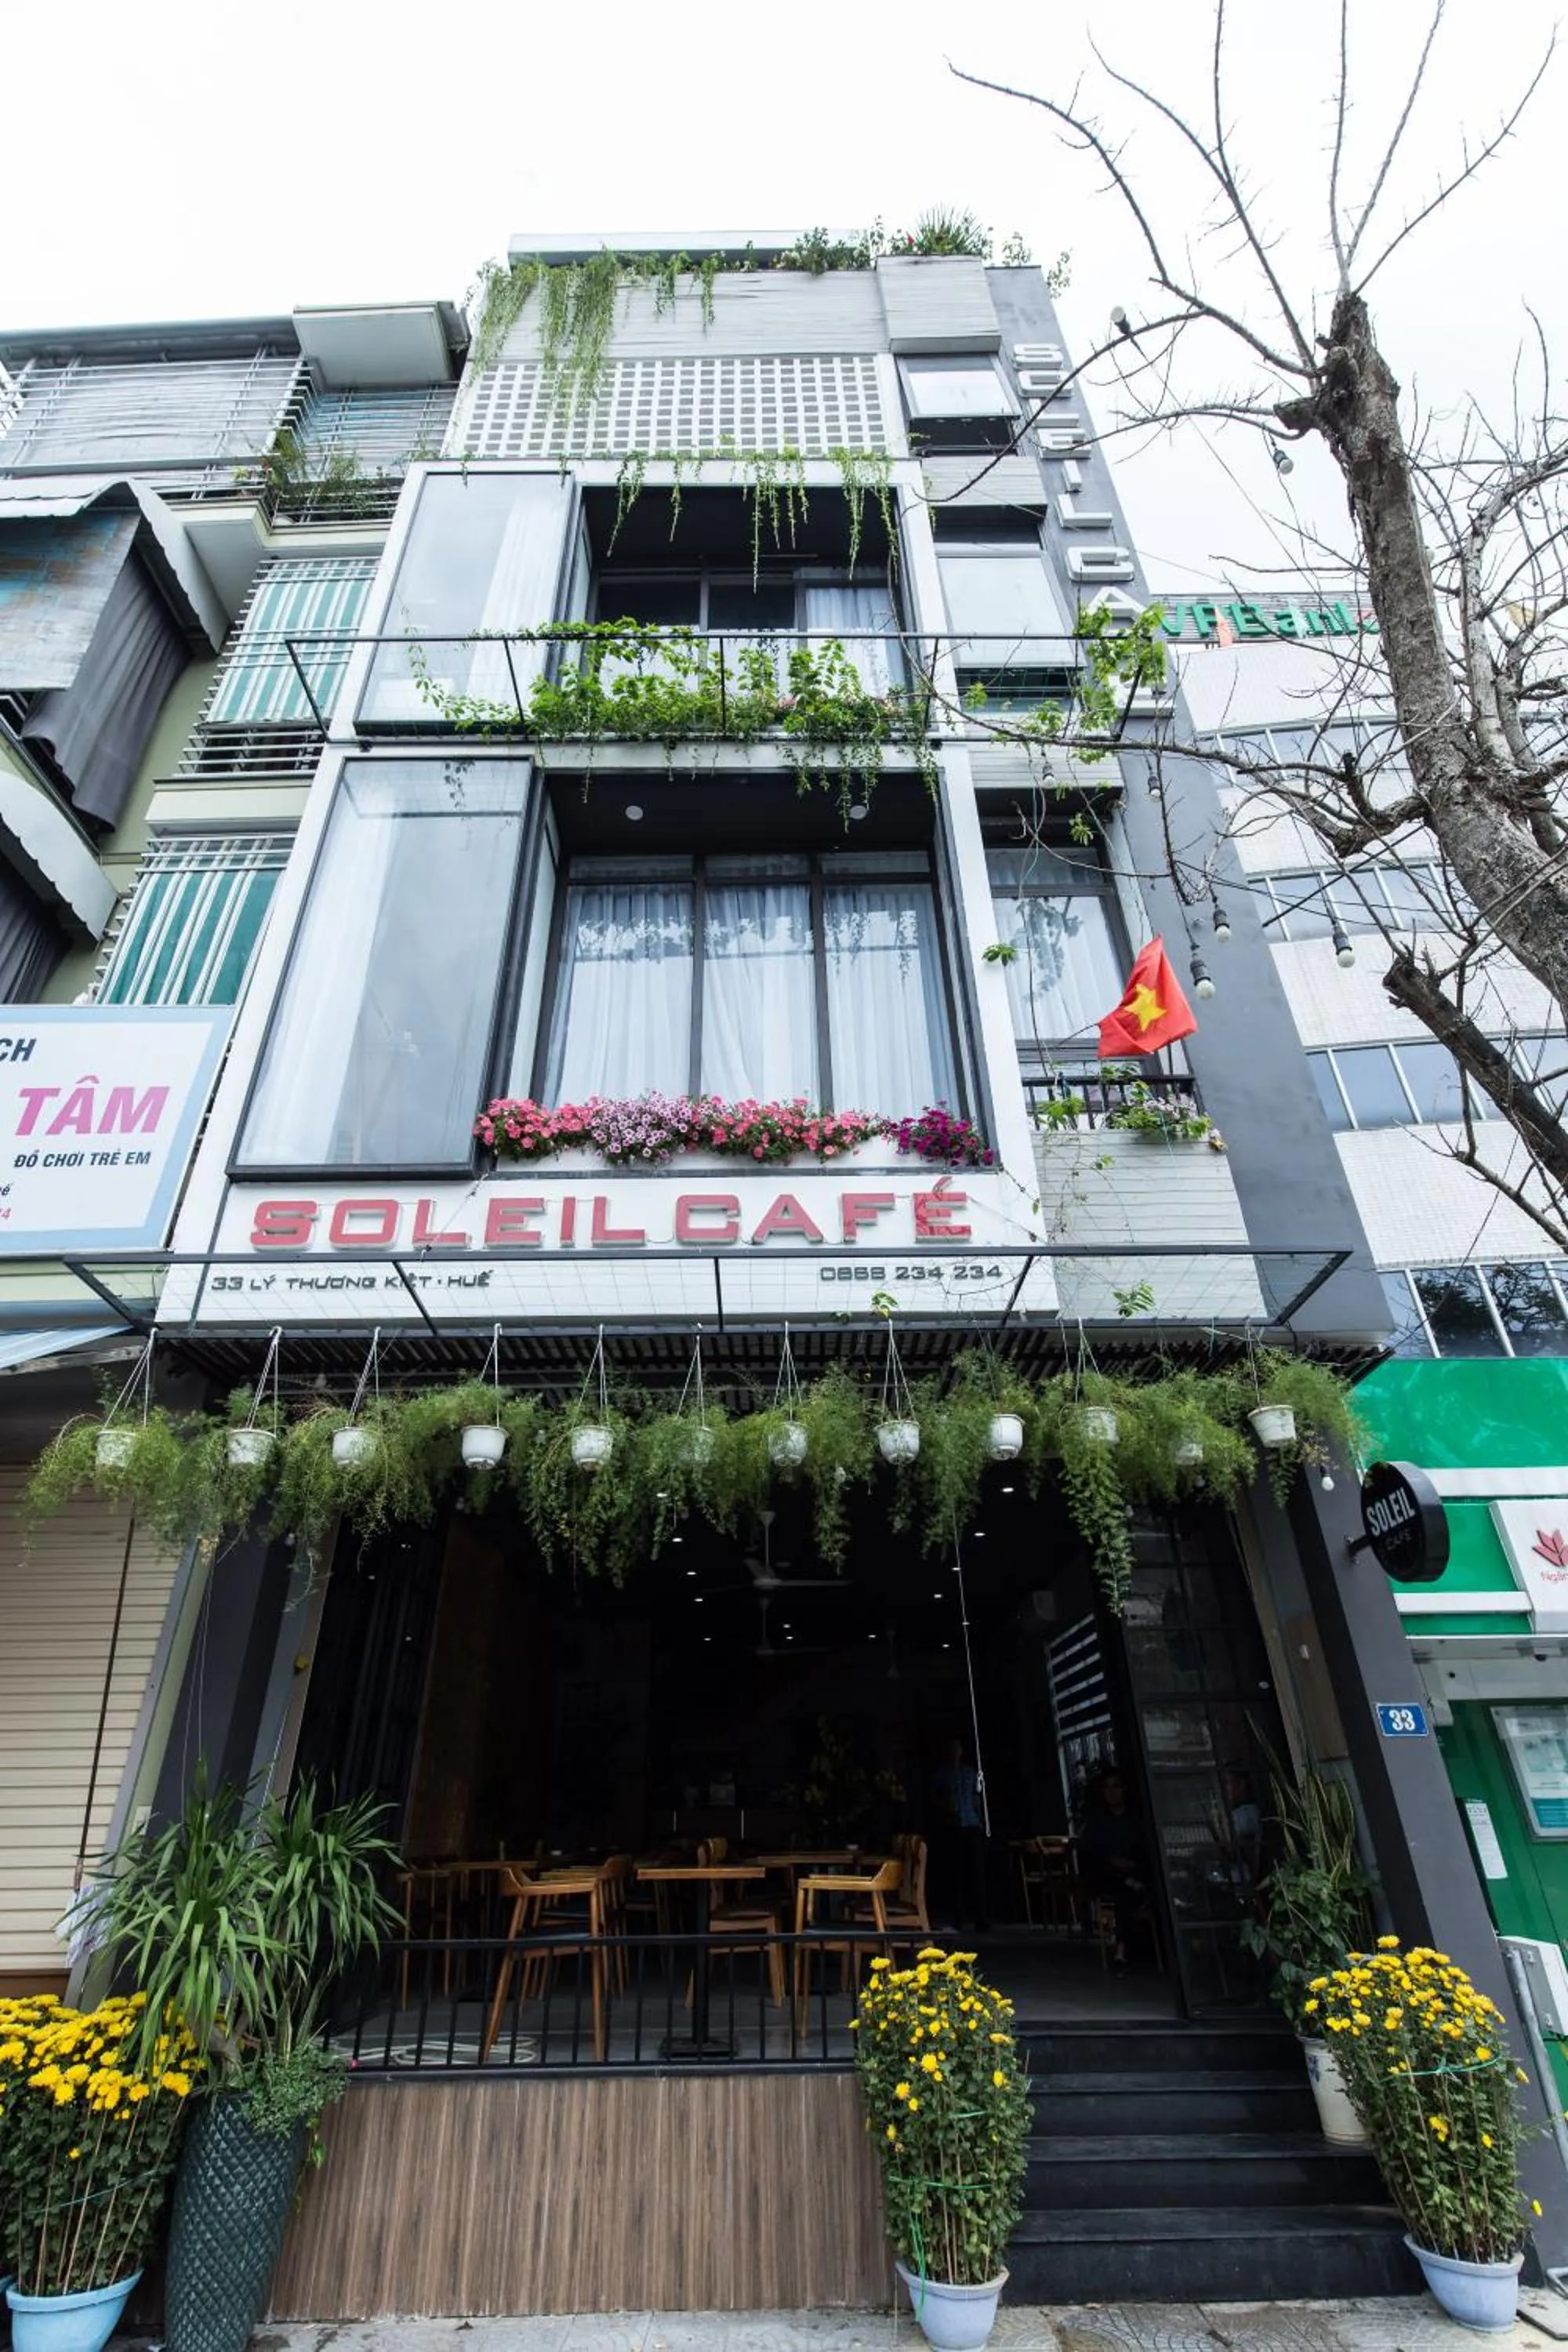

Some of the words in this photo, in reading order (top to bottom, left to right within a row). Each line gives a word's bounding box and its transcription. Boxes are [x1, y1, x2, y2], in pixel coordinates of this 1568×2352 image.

[1013, 343, 1113, 528] SOLEIL
[15, 1075, 170, 1136] TÂM
[125, 1151, 151, 1165] EM
[249, 1195, 645, 1251] SOLEIL
[676, 1176, 971, 1244] CAFÉ
[211, 1276, 243, 1290] 33
[250, 1274, 276, 1290] LÝ
[448, 1269, 493, 1288] HUẾ
[895, 1266, 944, 1280] 234
[953, 1265, 1003, 1279] 234
[1367, 1486, 1416, 1537] SOLEIL
[1388, 1709, 1416, 1730] 33
